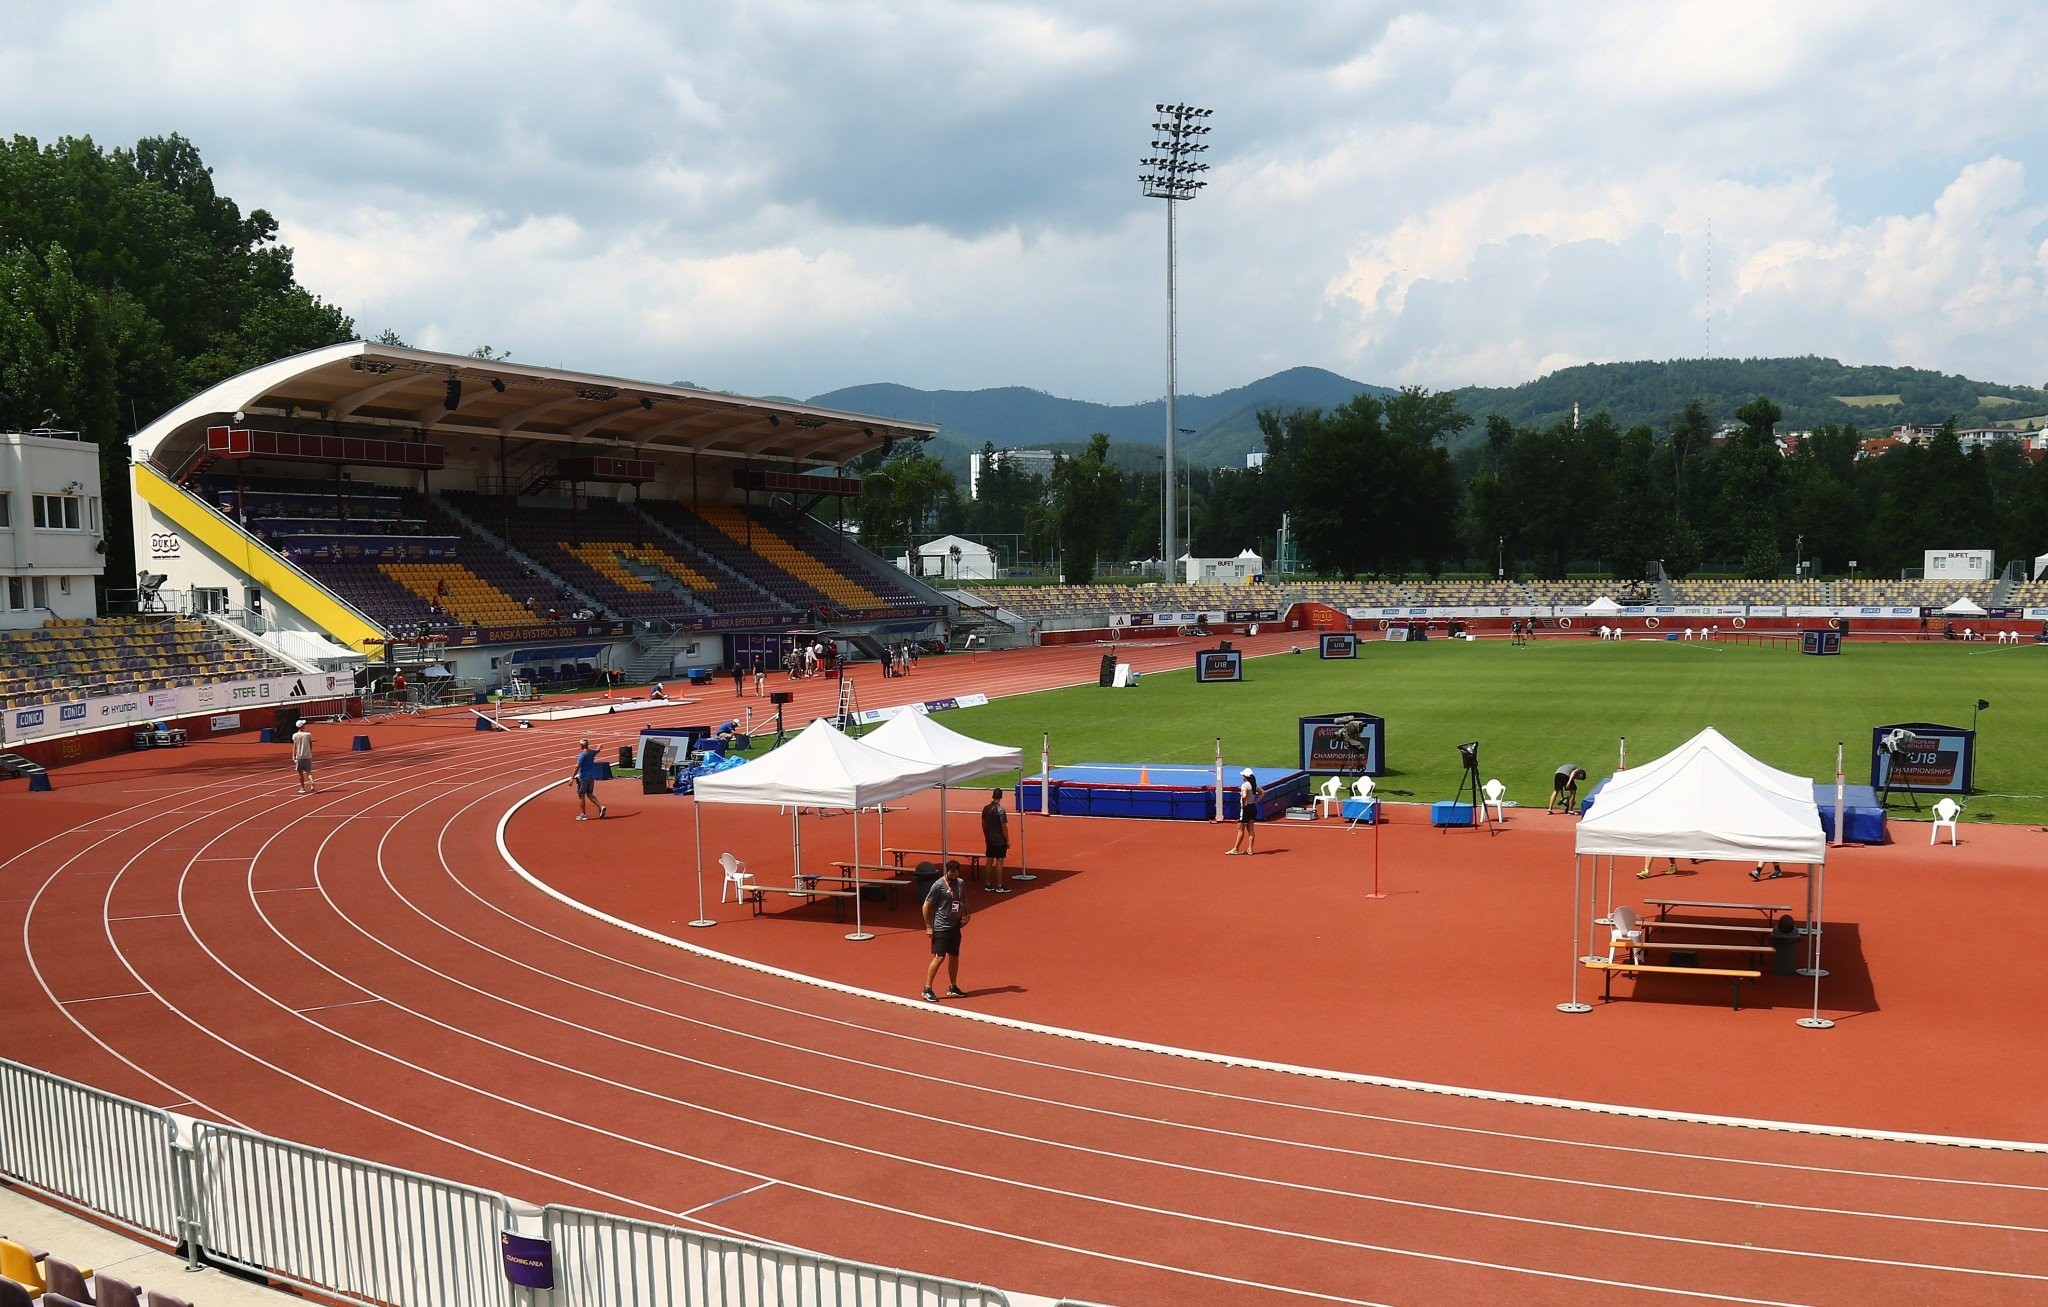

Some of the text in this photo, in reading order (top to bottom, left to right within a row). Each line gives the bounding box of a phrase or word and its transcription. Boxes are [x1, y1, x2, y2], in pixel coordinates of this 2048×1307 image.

[152, 538, 180, 548] DUKLA
[735, 616, 761, 627] BYSTRICA
[762, 616, 774, 625] 2024
[489, 628, 521, 641] BANSKÁ
[522, 628, 558, 639] BYSTRICA
[559, 627, 577, 637] 2024
[1214, 661, 1228, 669] U18
[233, 686, 256, 699] STEFE
[63, 706, 86, 719] CONICA
[111, 702, 138, 714] HYUNDAI
[20, 713, 43, 727] CONICA
[506, 1254, 544, 1268] COACHING AREA
